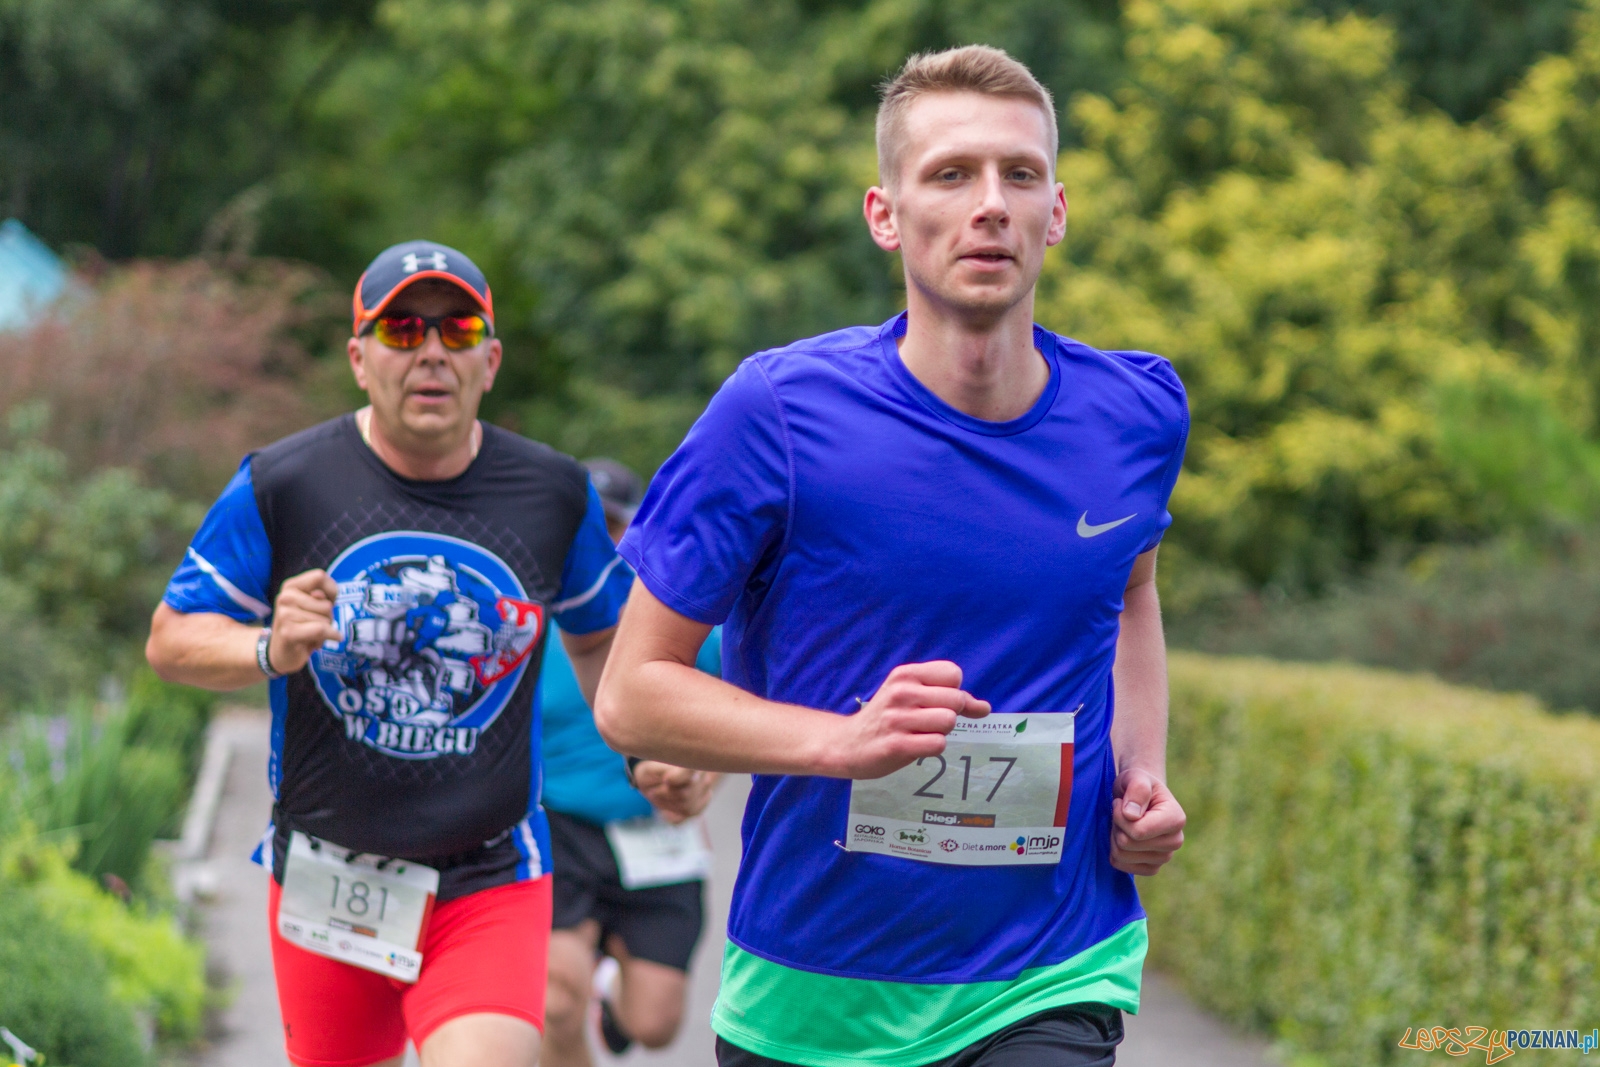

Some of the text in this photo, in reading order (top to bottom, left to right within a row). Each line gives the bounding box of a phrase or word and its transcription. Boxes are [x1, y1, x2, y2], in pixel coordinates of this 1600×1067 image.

[343, 713, 478, 755] W BIEGU
[912, 754, 1018, 802] 217
[855, 824, 886, 836] GOKO
[1029, 835, 1060, 850] mjp
[962, 842, 978, 851] Diet
[330, 875, 388, 921] 181
